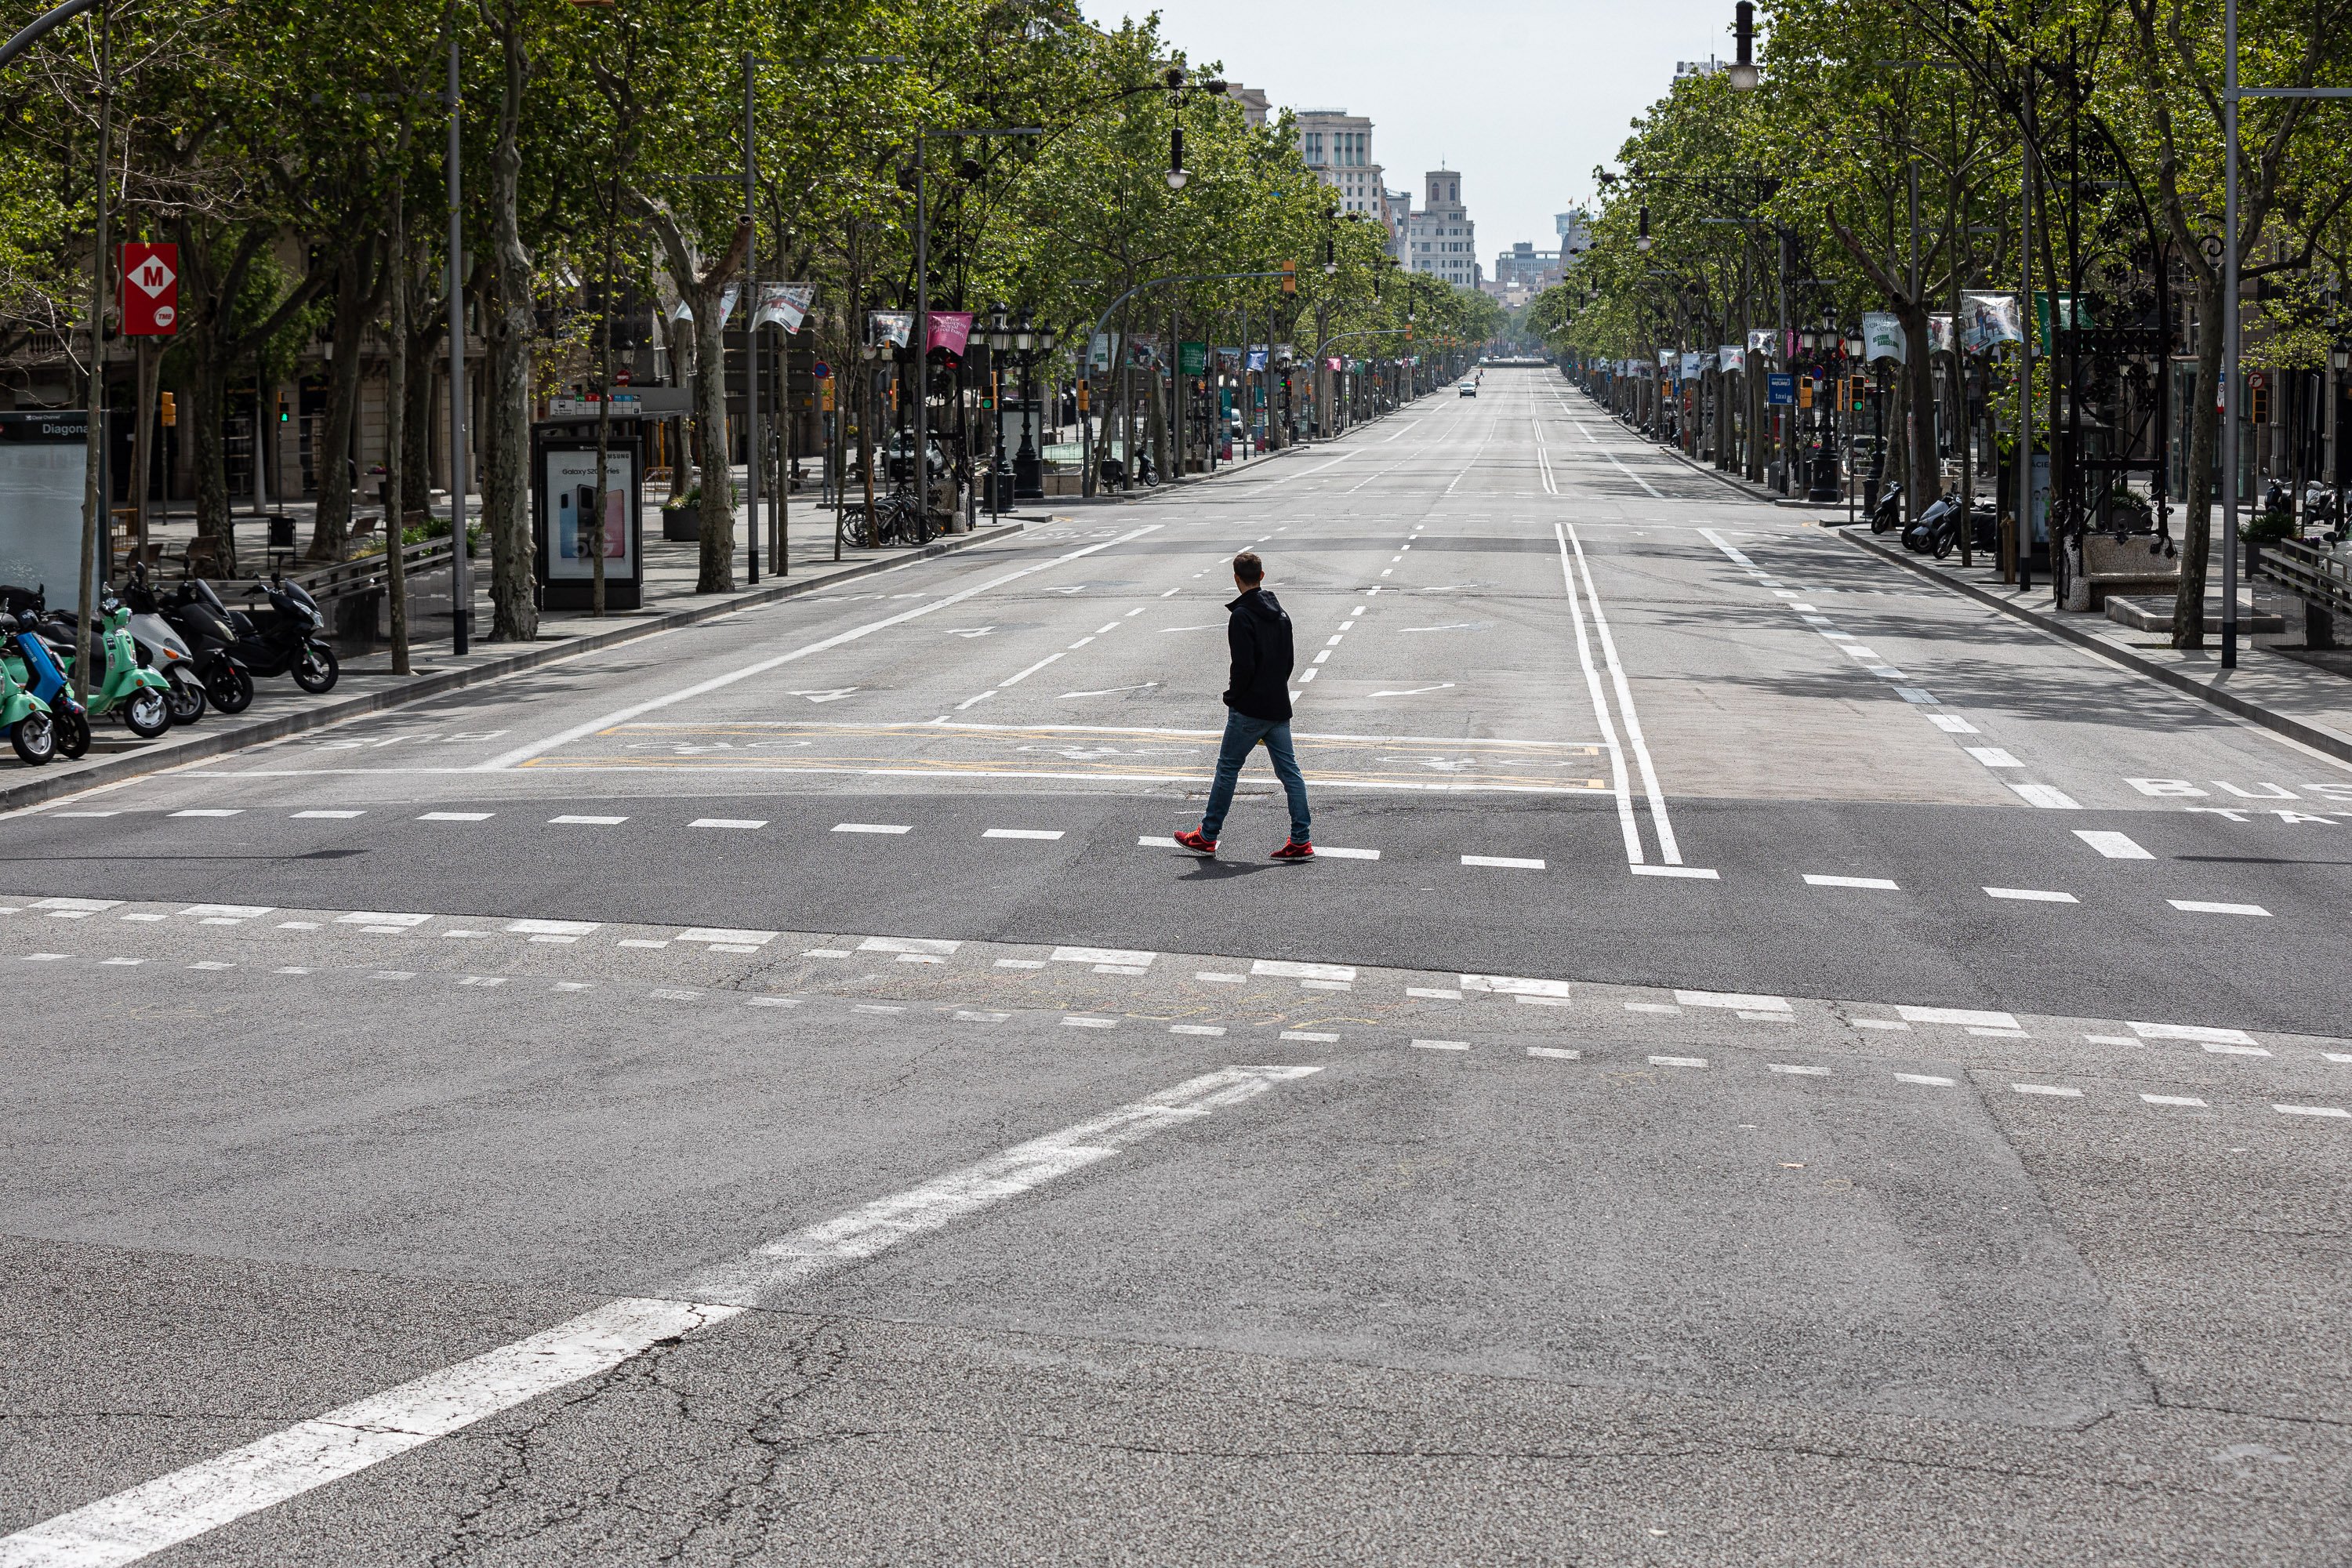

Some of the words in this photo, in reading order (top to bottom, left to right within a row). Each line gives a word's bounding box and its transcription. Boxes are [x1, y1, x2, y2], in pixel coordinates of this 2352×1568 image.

[143, 266, 164, 287] M
[42, 423, 88, 436] Diagona
[2032, 459, 2049, 468] ÀCIE
[572, 532, 614, 557] 5G
